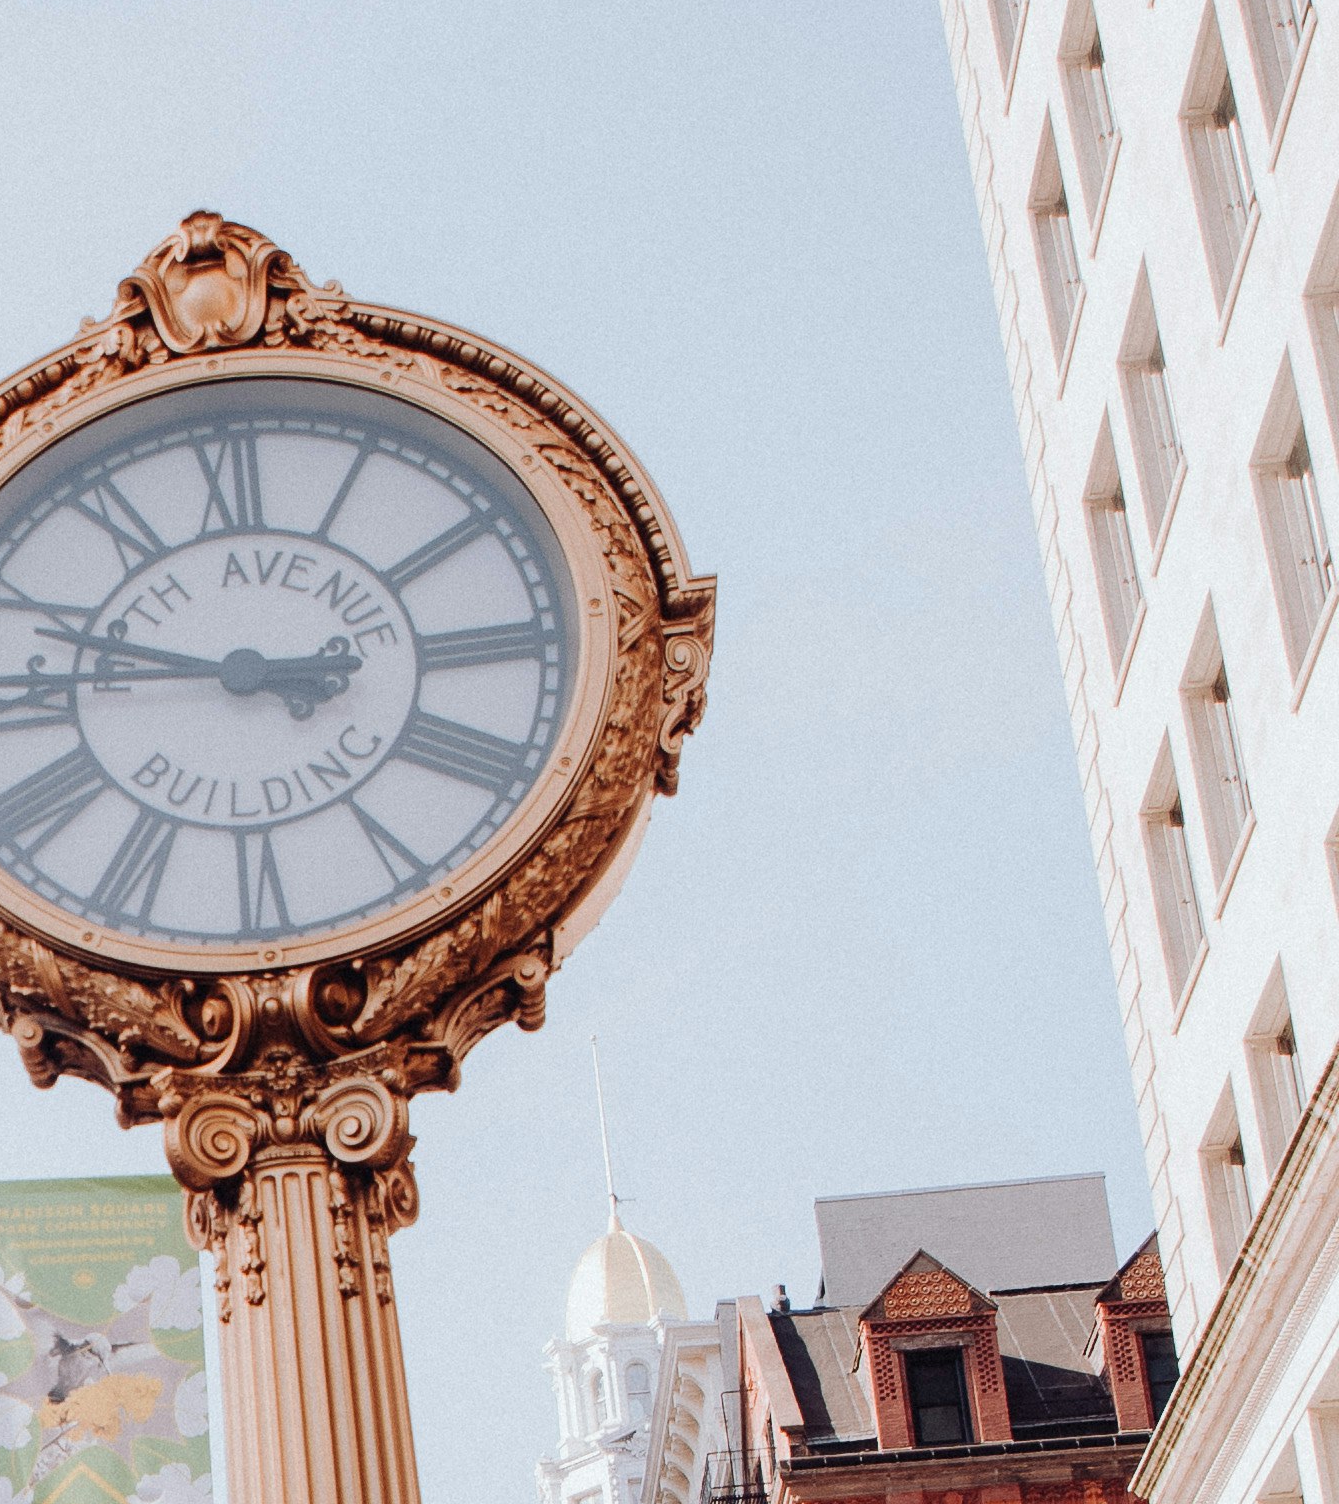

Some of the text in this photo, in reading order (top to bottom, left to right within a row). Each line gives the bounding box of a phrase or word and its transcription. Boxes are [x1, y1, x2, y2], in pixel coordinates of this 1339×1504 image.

[195, 437, 268, 534] XII
[92, 550, 398, 692] FTH AVENUE
[131, 723, 382, 818] BUILDING
